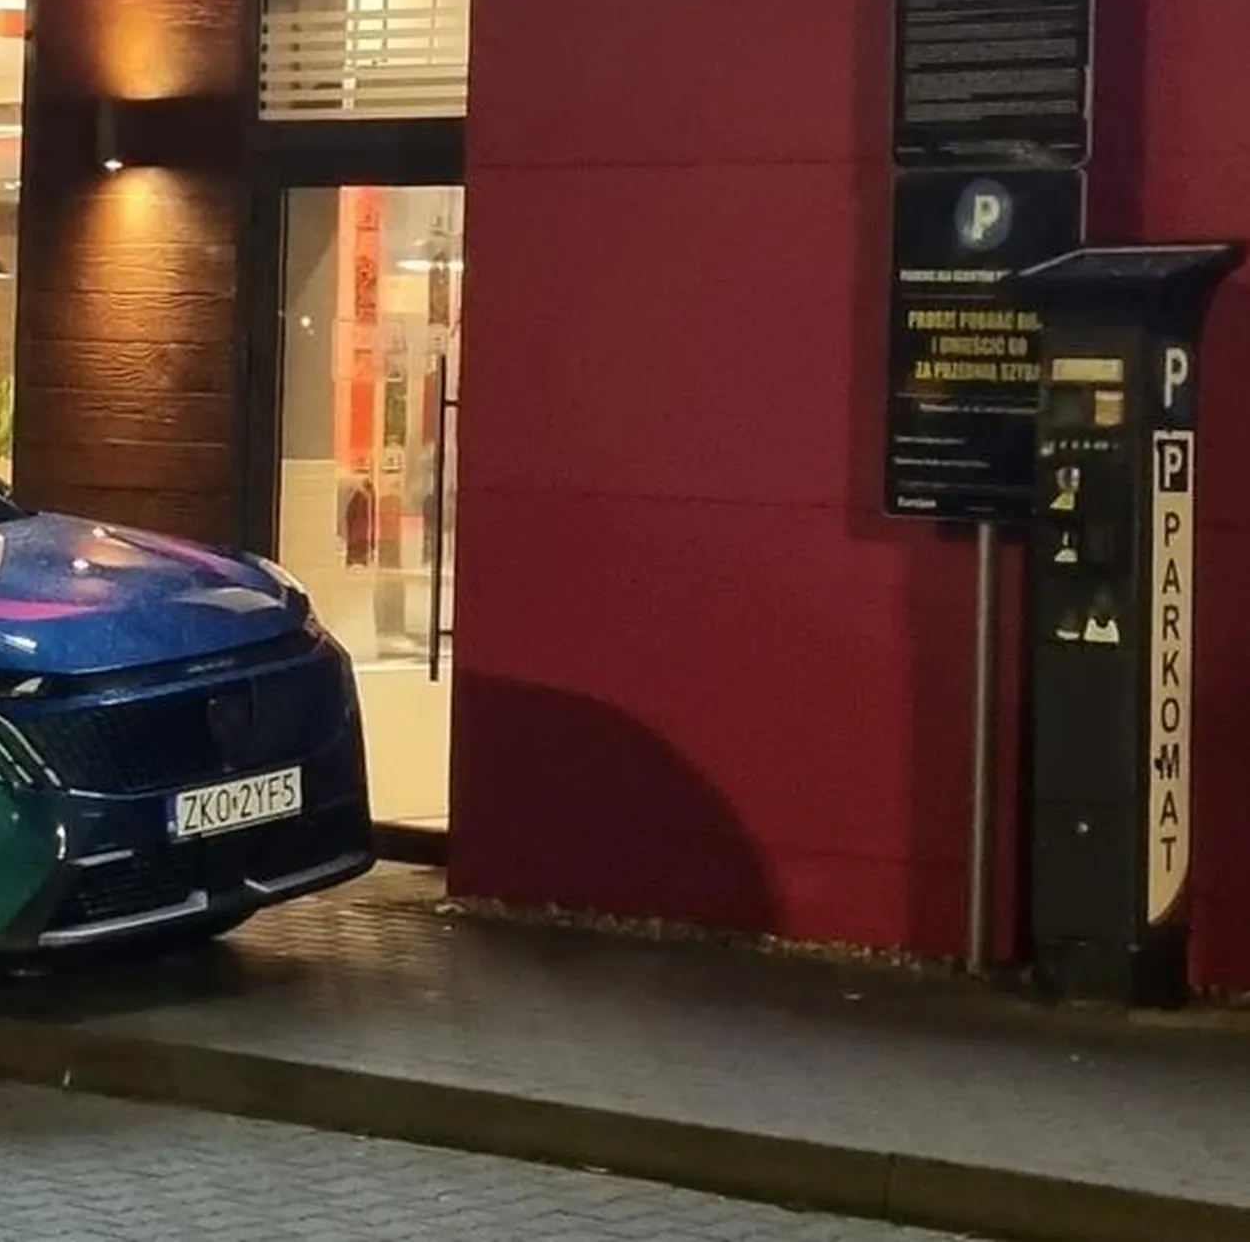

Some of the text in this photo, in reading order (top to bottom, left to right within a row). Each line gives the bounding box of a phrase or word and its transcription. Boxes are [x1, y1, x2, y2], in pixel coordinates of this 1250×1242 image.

[971, 194, 1000, 241] P
[1163, 346, 1189, 409] P
[1162, 443, 1184, 489] P
[1159, 510, 1182, 873] PARKOMAT
[239, 771, 296, 820] 2YF5
